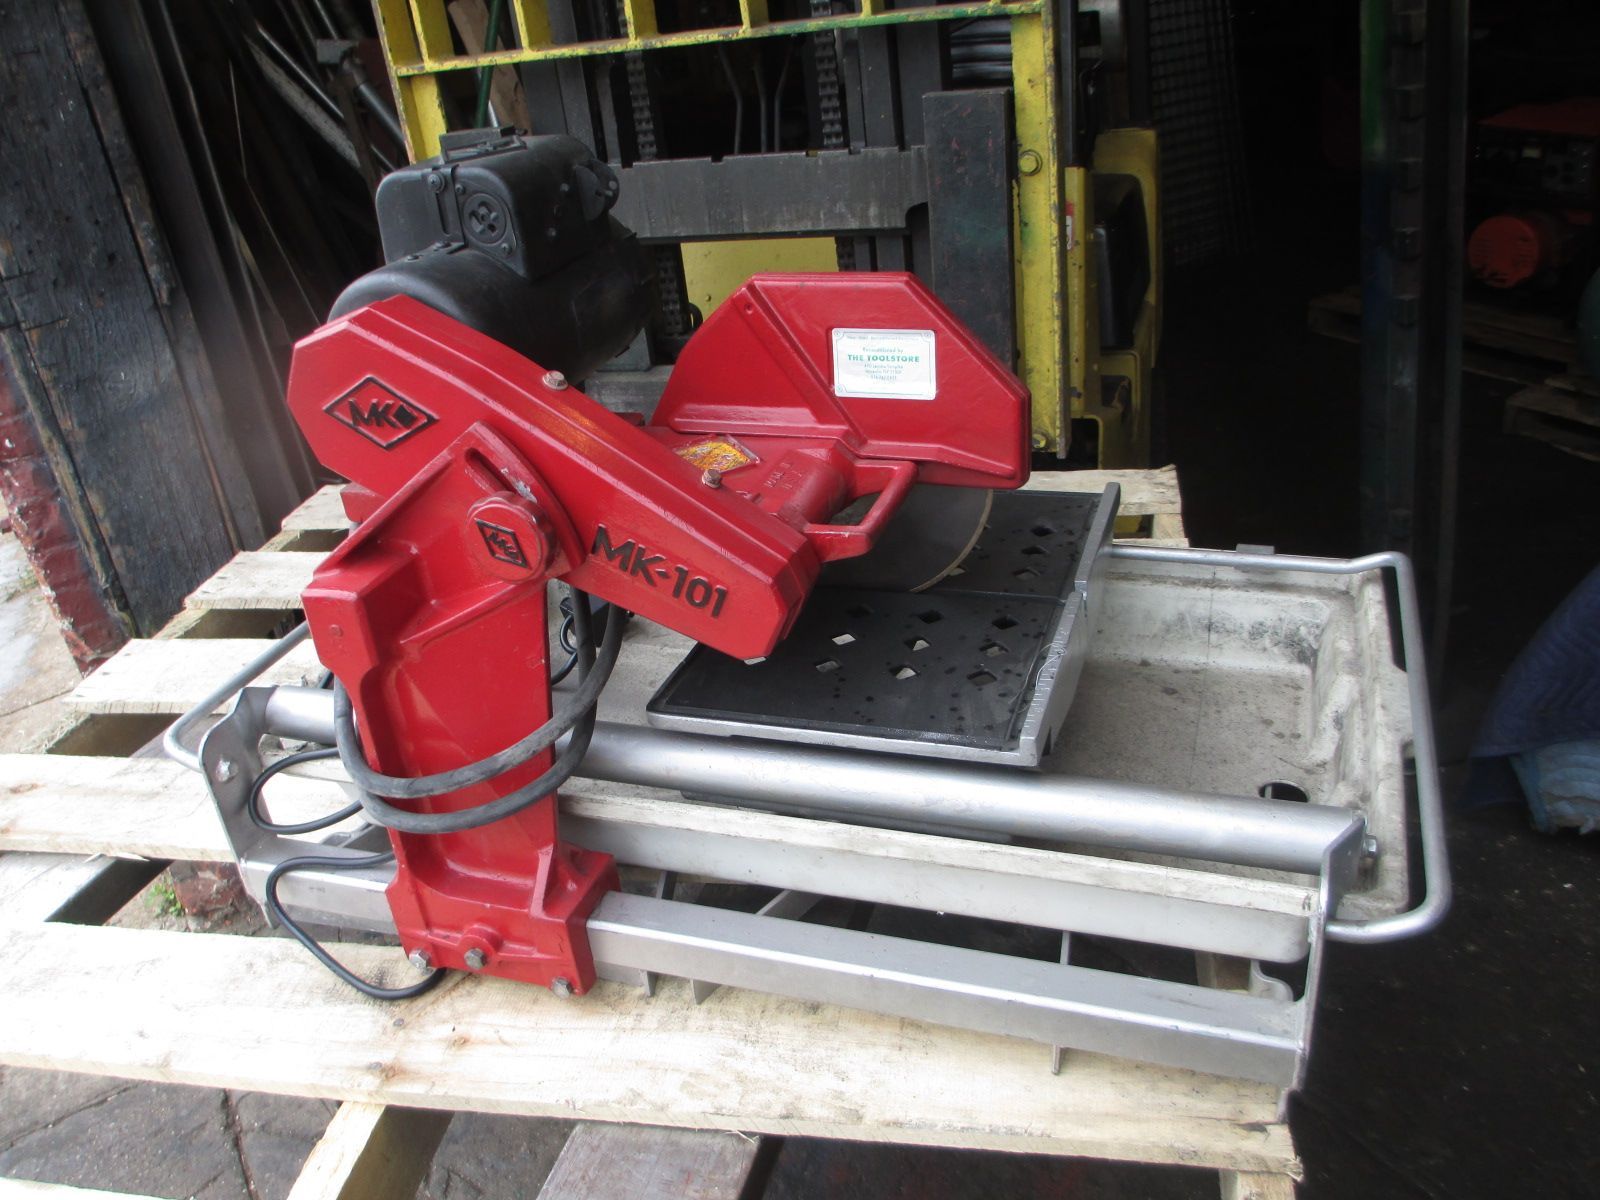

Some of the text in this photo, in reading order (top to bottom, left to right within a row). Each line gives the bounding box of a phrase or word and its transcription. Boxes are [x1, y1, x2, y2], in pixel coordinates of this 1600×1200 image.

[867, 354, 920, 363] TOOLSTORE
[347, 399, 401, 429] MK
[591, 523, 728, 618] MK-101
